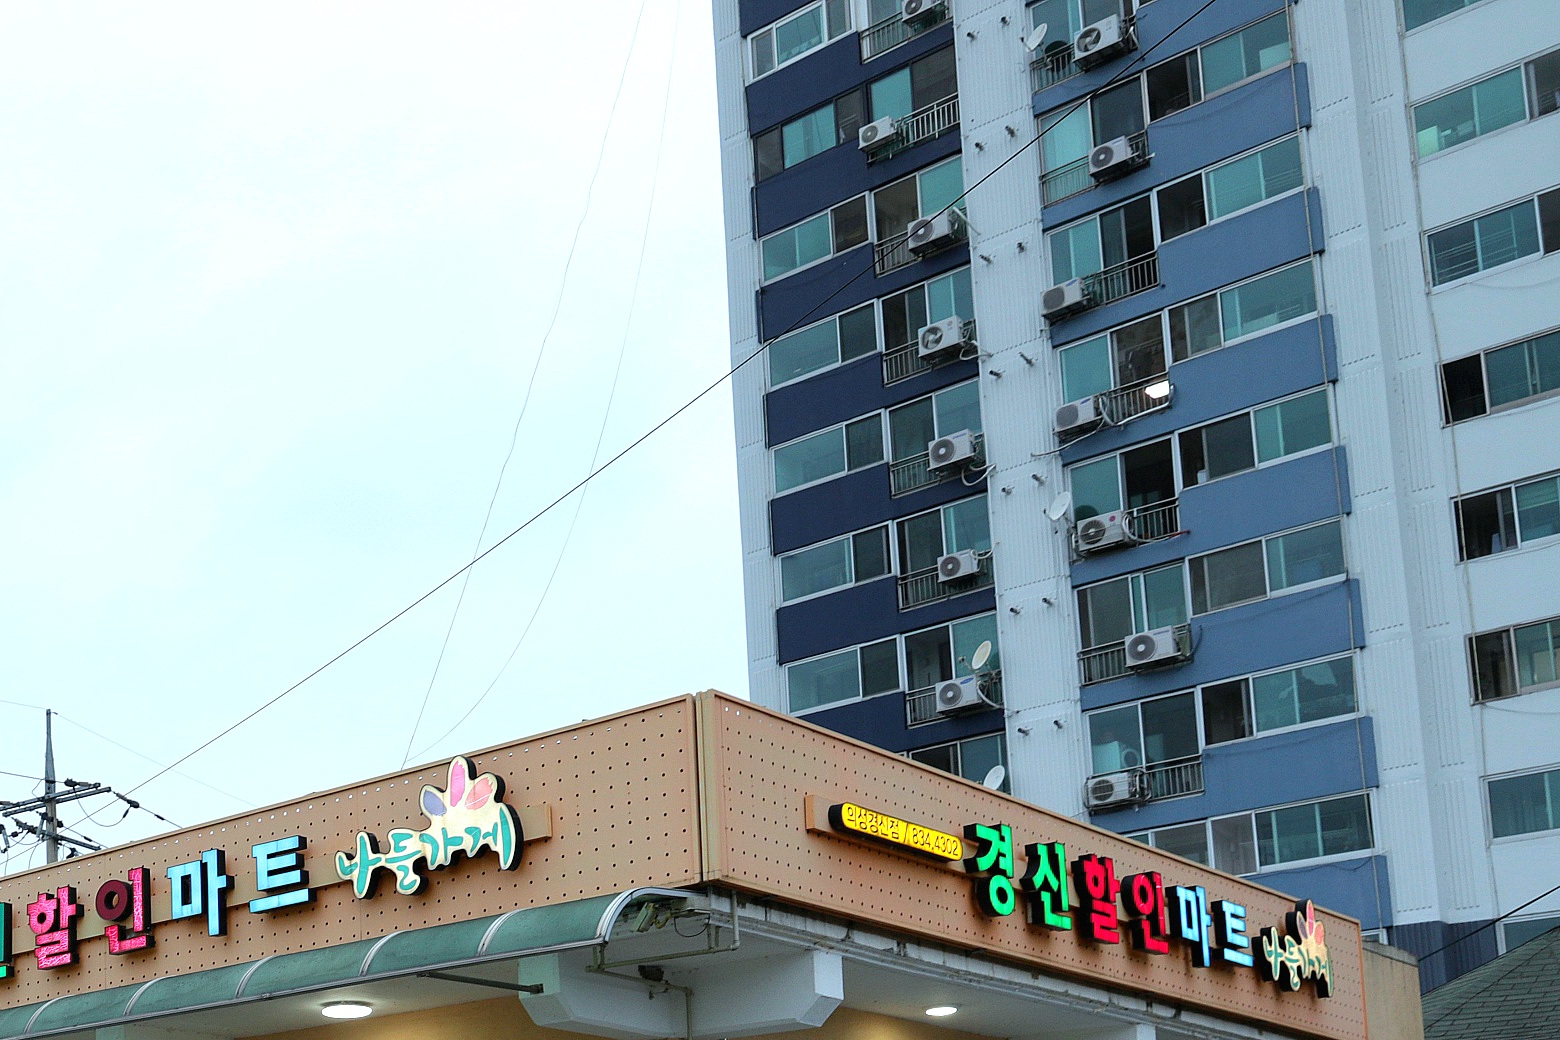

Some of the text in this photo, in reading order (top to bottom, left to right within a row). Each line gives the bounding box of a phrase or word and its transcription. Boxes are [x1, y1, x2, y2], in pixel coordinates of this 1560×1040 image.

[338, 808, 517, 898] 나들가게
[847, 806, 900, 840] 의성경신점
[912, 827, 959, 857] 834.4302
[1262, 927, 1334, 996] 나들가게
